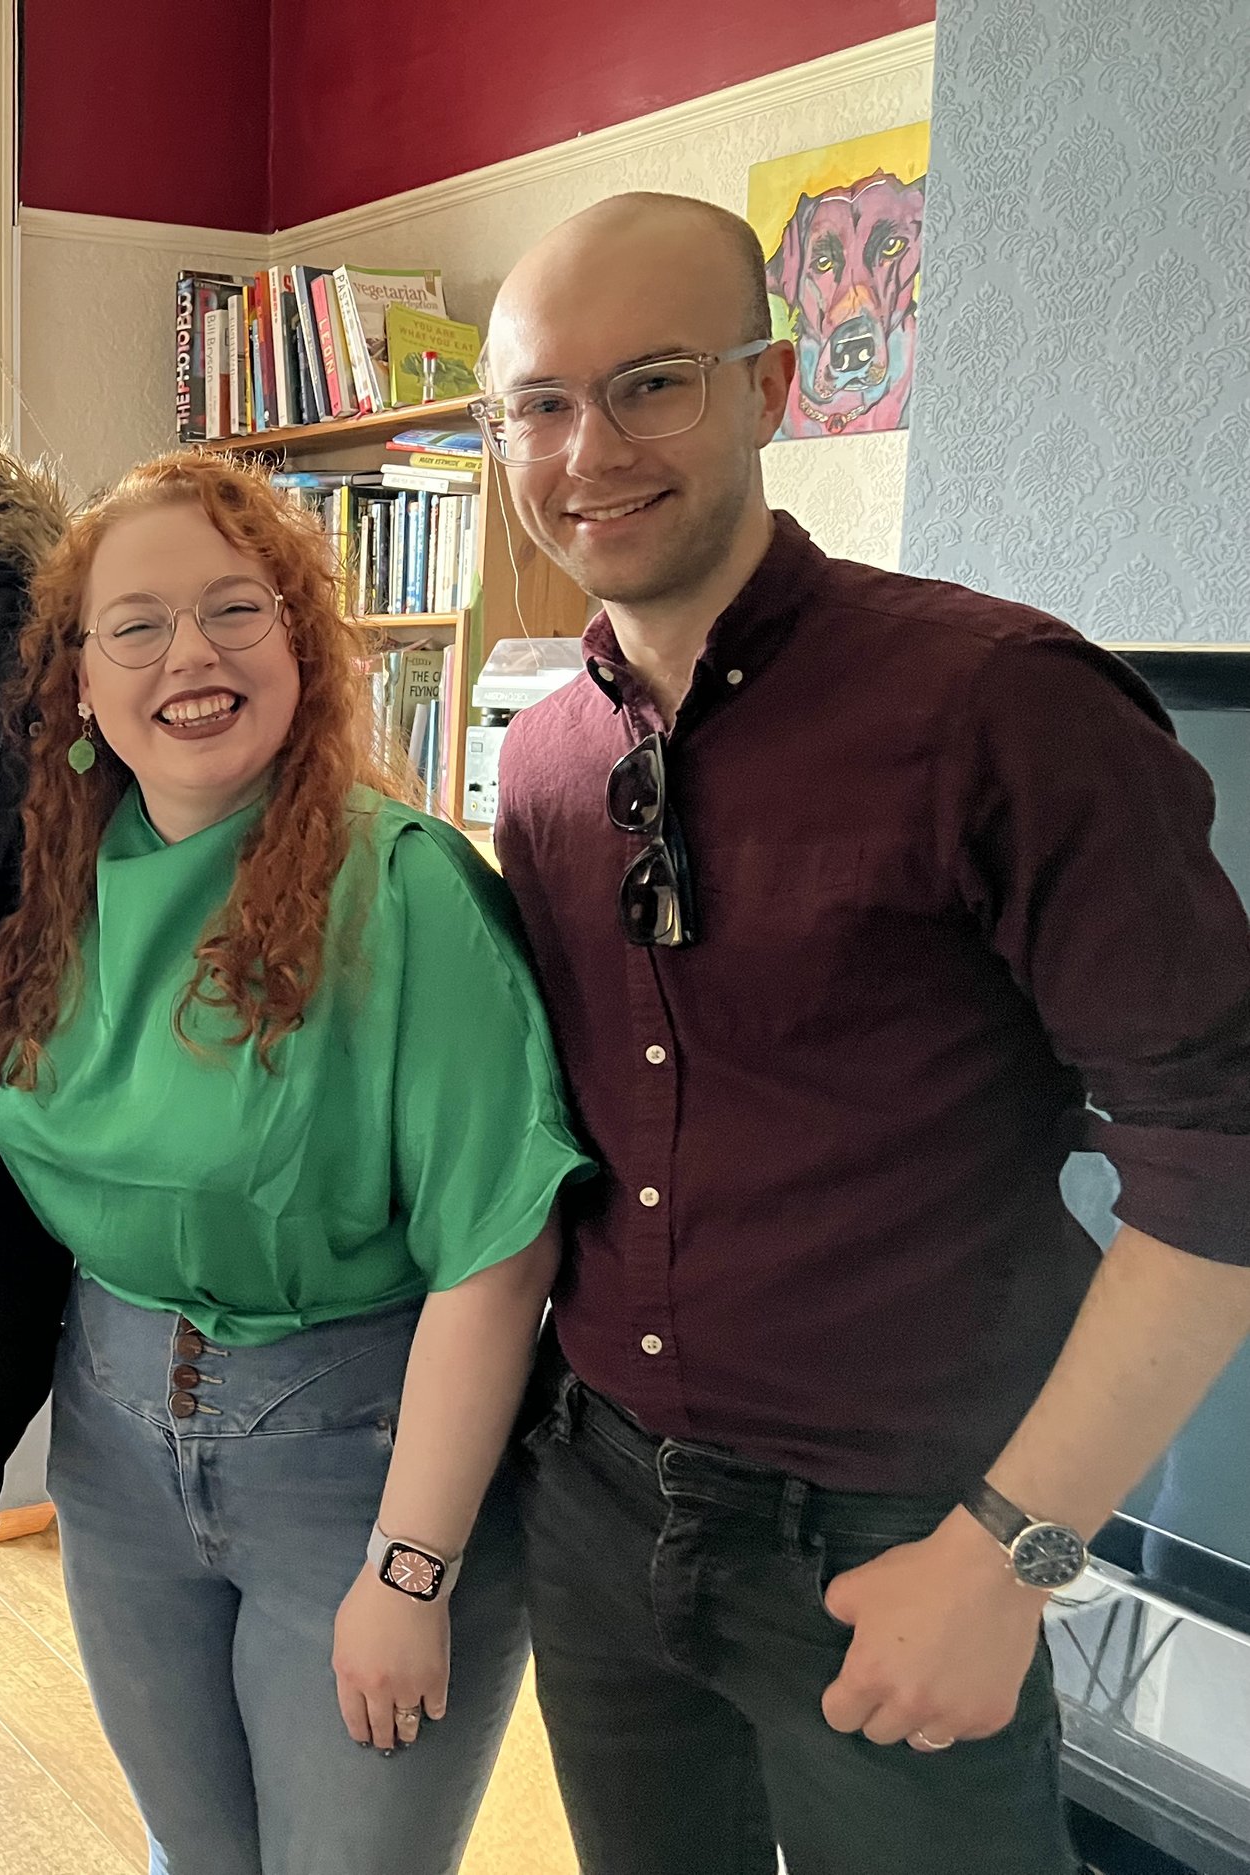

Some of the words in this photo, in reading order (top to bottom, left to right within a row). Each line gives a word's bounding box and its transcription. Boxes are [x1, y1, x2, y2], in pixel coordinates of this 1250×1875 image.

[353, 281, 429, 301] vegetarian
[206, 315, 216, 336] Bill
[413, 320, 433, 333] YOU
[436, 326, 455, 339] ARE
[318, 317, 335, 375] LEON
[399, 325, 426, 341] WHAT
[430, 336, 450, 347] YOU
[454, 341, 473, 352] EAT
[206, 338, 216, 383] Bryson
[412, 671, 429, 683] THE
